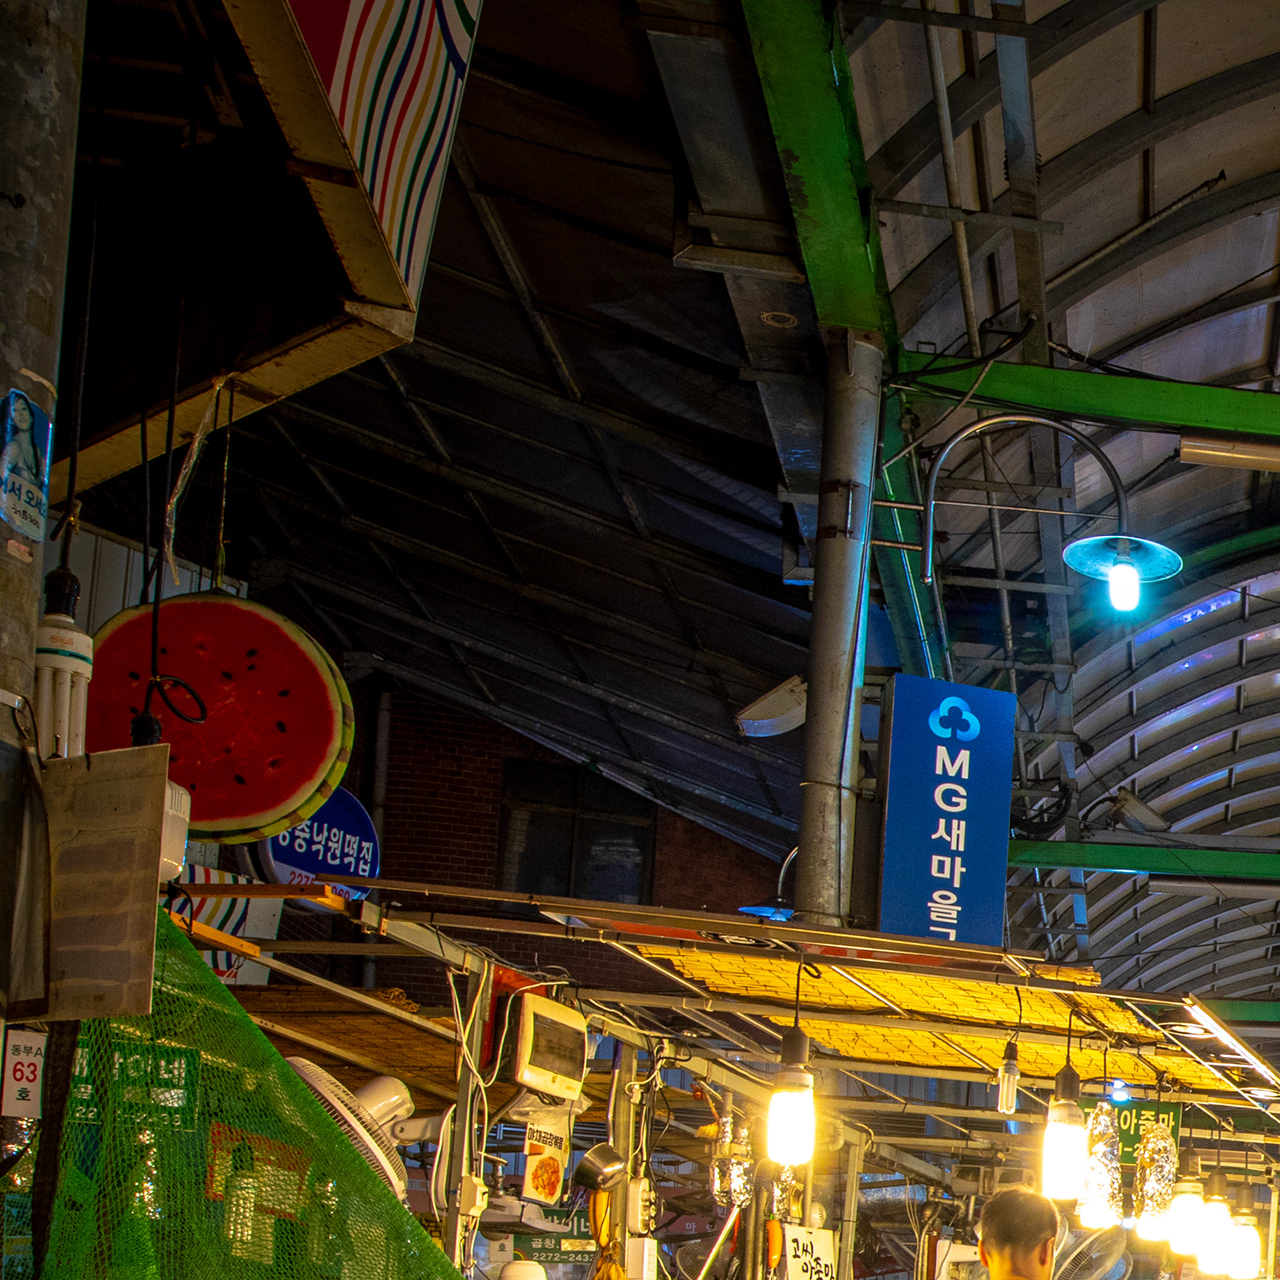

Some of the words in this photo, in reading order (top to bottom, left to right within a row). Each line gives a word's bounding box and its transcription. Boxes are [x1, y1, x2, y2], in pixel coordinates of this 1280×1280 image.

[11, 1044, 44, 1058] 동부A
[13, 1061, 38, 1083] 63
[16, 1087, 31, 1102] 호
[791, 1237, 815, 1259] 고씨
